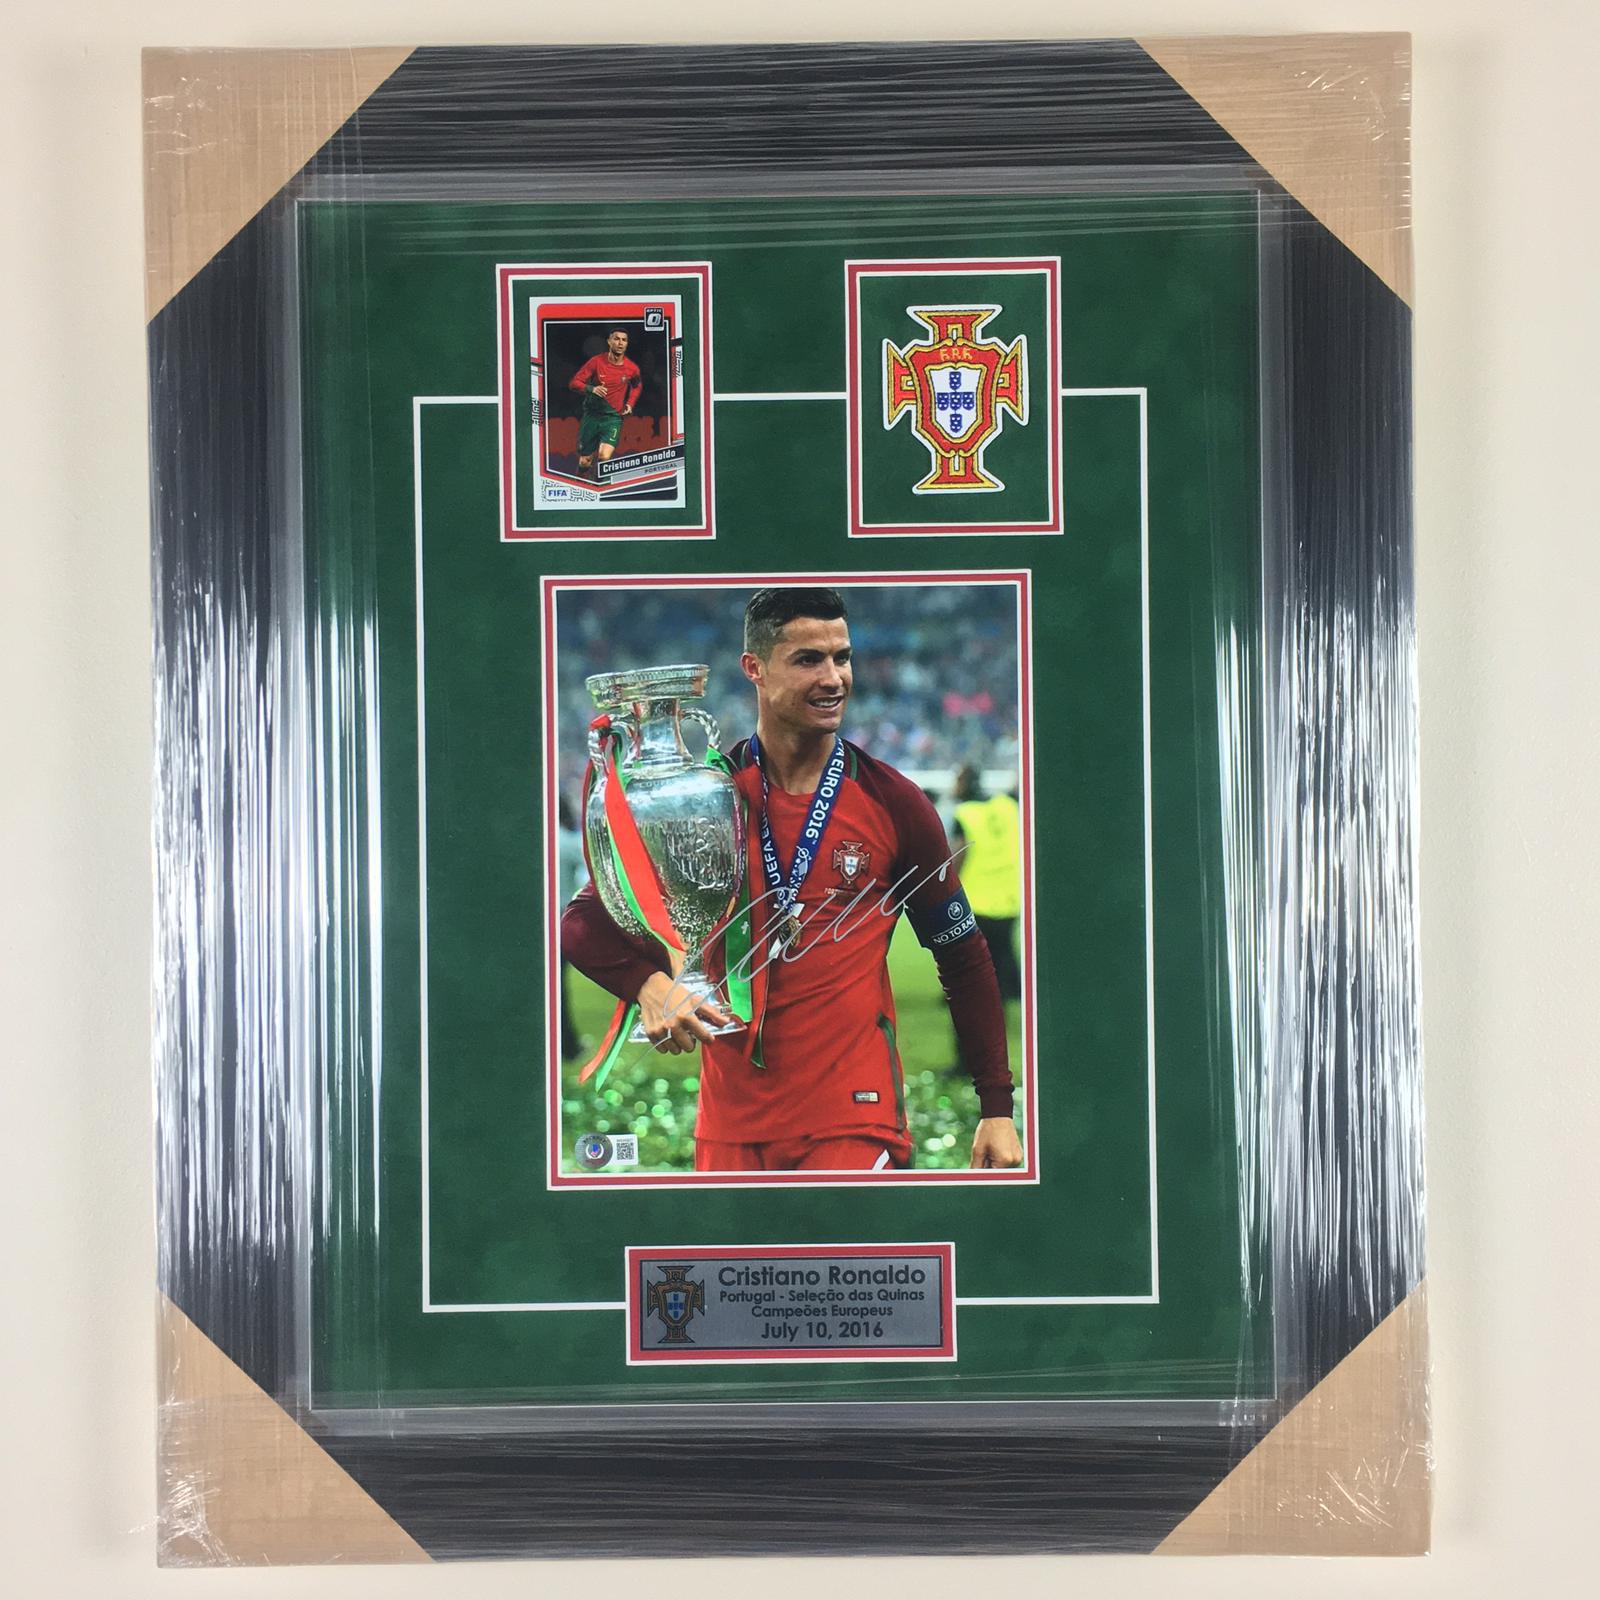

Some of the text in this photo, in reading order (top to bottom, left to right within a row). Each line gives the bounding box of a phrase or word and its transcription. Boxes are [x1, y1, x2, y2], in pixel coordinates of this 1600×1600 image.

[602, 449, 676, 473] Cristiano Ronaldo
[644, 463, 678, 474] PORTUGAL
[548, 489, 568, 497] FIFA
[805, 758, 845, 839] EURO 2016
[763, 840, 781, 885] UEFA
[933, 934, 949, 944] NO
[948, 927, 962, 938] TO
[718, 1264, 926, 1287] Cristiano Ronaldo
[720, 1290, 776, 1305] Portugal
[788, 1289, 845, 1304] Seleção
[848, 1289, 874, 1301] das
[877, 1288, 925, 1302] Quinas
[751, 1304, 894, 1320] Campeões Europeus
[761, 1321, 884, 1342] July 10, 2016
